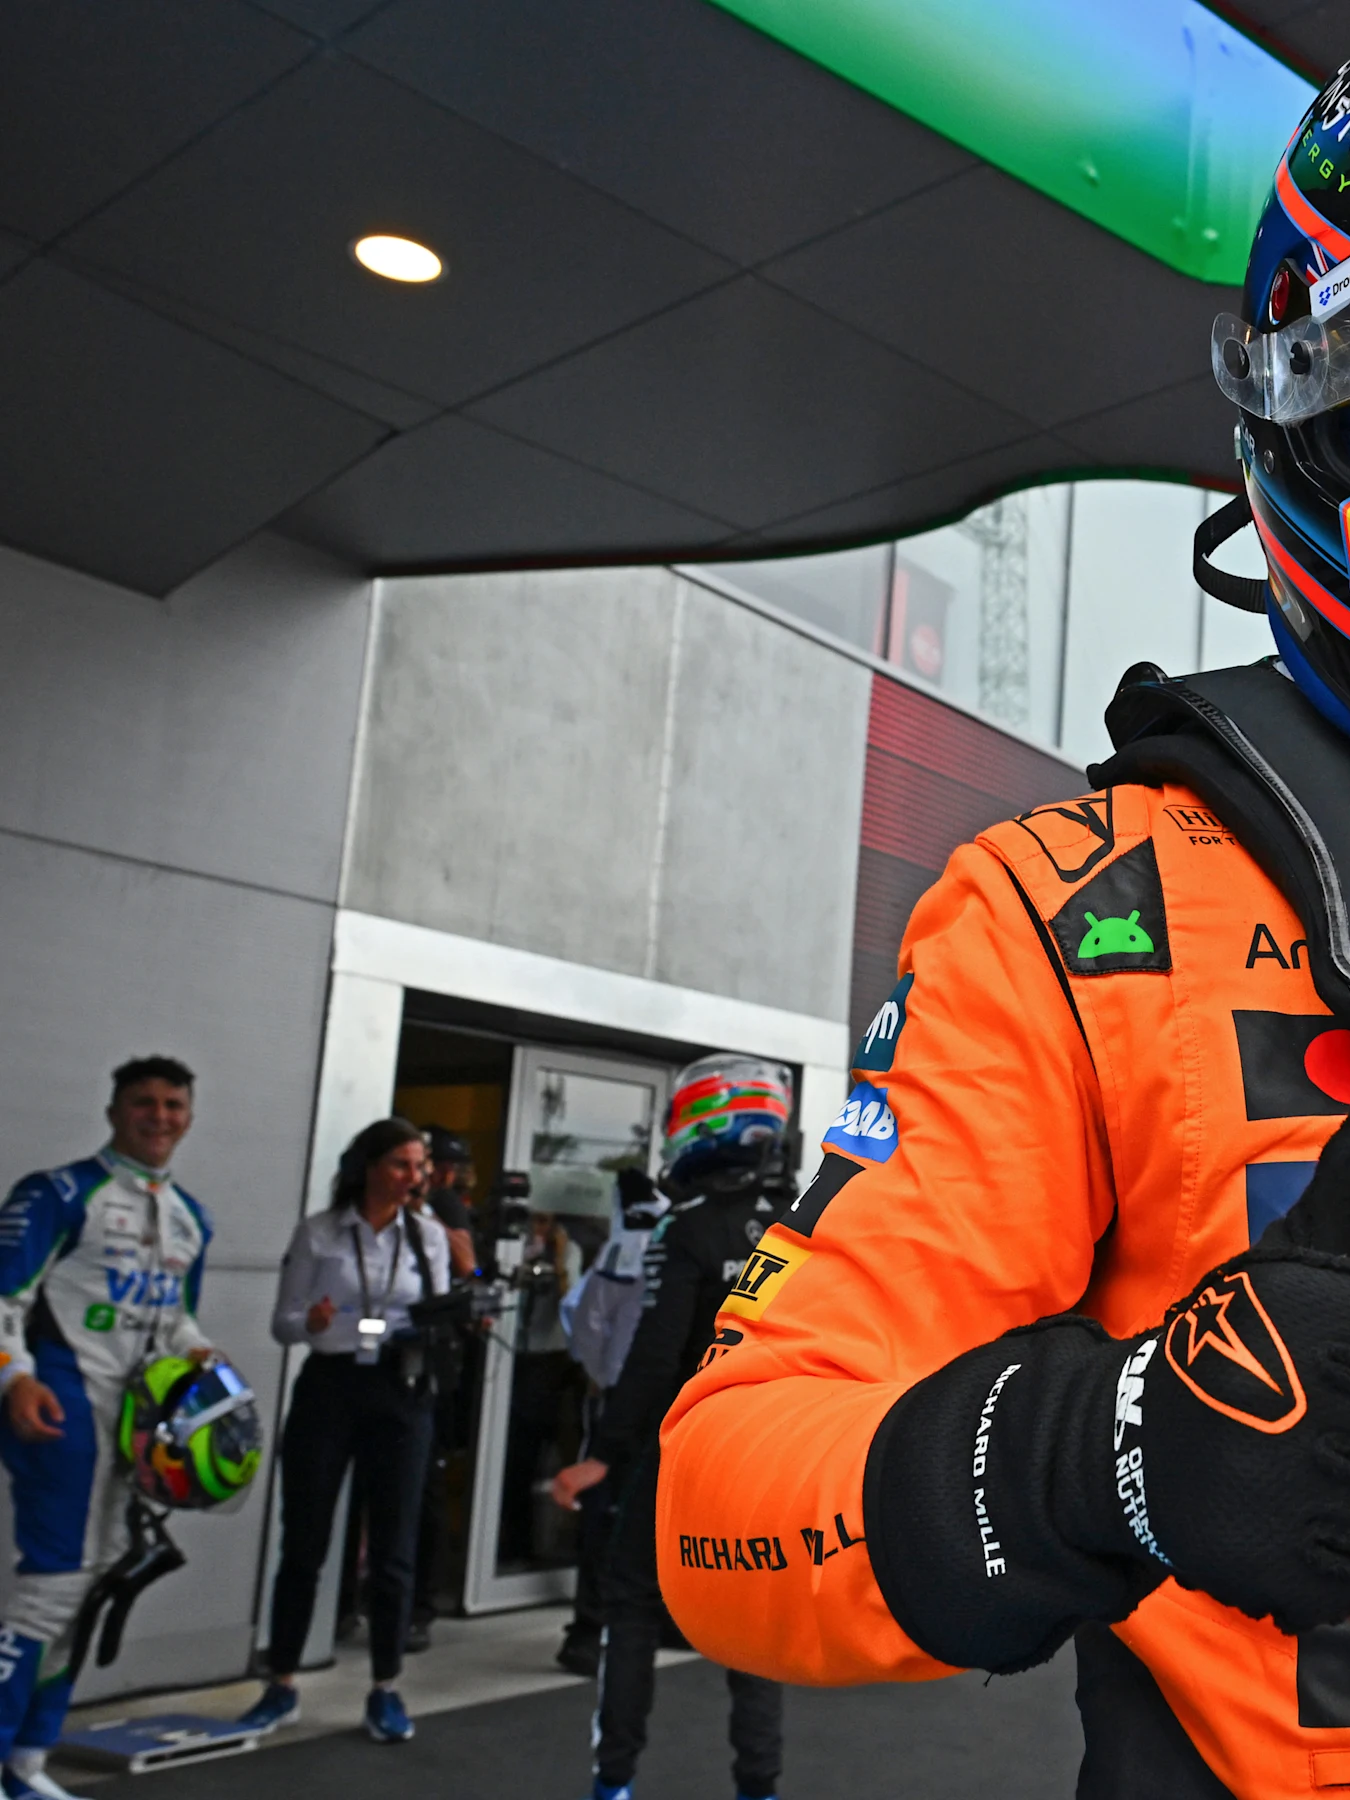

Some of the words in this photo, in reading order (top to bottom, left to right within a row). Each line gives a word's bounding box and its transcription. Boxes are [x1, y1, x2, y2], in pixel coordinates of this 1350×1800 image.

[1189, 836, 1223, 846] FOR
[973, 1363, 1022, 1478] RICHARD
[974, 1487, 1007, 1578] MILLE
